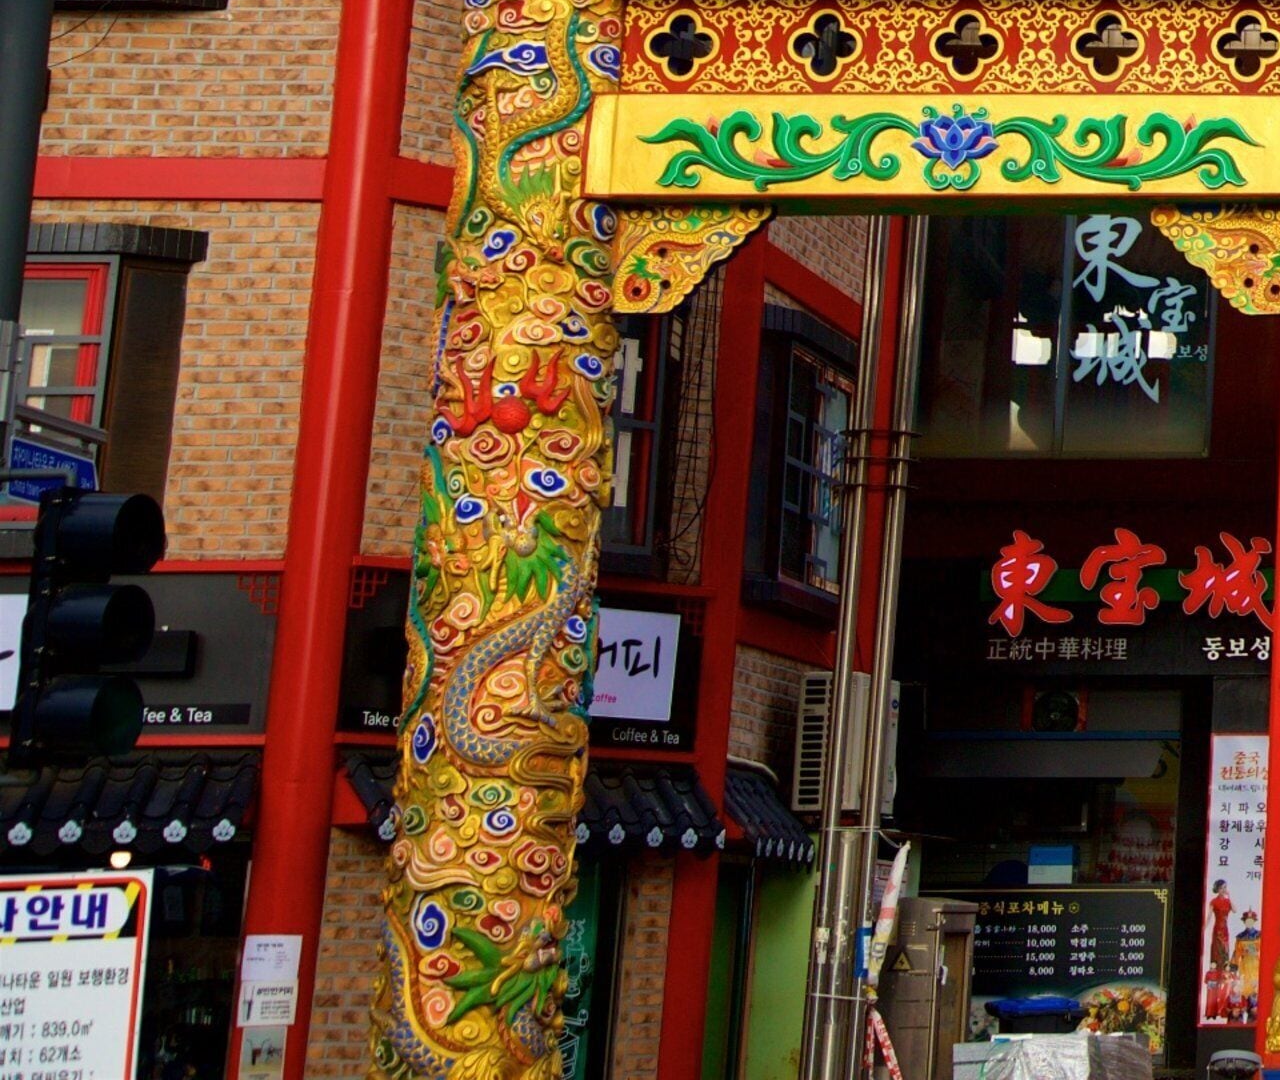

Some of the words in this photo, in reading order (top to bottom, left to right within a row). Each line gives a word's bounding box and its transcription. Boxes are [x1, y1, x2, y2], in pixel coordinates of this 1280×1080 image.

[987, 637, 1128, 660] 正統中華料理
[1202, 636, 1270, 660] 동보성
[592, 694, 616, 703] offee
[170, 707, 182, 722] &
[187, 707, 212, 723] Tea
[363, 711, 390, 727] Take
[613, 727, 648, 742] Coffee
[650, 729, 658, 742] &
[662, 730, 679, 744] Tea
[1234, 751, 1260, 765] 중국
[1027, 924, 1057, 935] 18,000
[1071, 924, 1089, 934] 소주
[1120, 924, 1146, 935] 3,000
[1026, 938, 1056, 948] 10,000
[1120, 938, 1145, 948] 3,000
[1025, 952, 1055, 962] 15,000
[1119, 952, 1144, 962] 5,000
[1028, 966, 1055, 976] 8,000
[1118, 966, 1144, 976] 6,000
[0, 971, 41, 990] 나타운
[78, 968, 129, 986] 보행환경
[39, 1045, 81, 1063] 62개소
